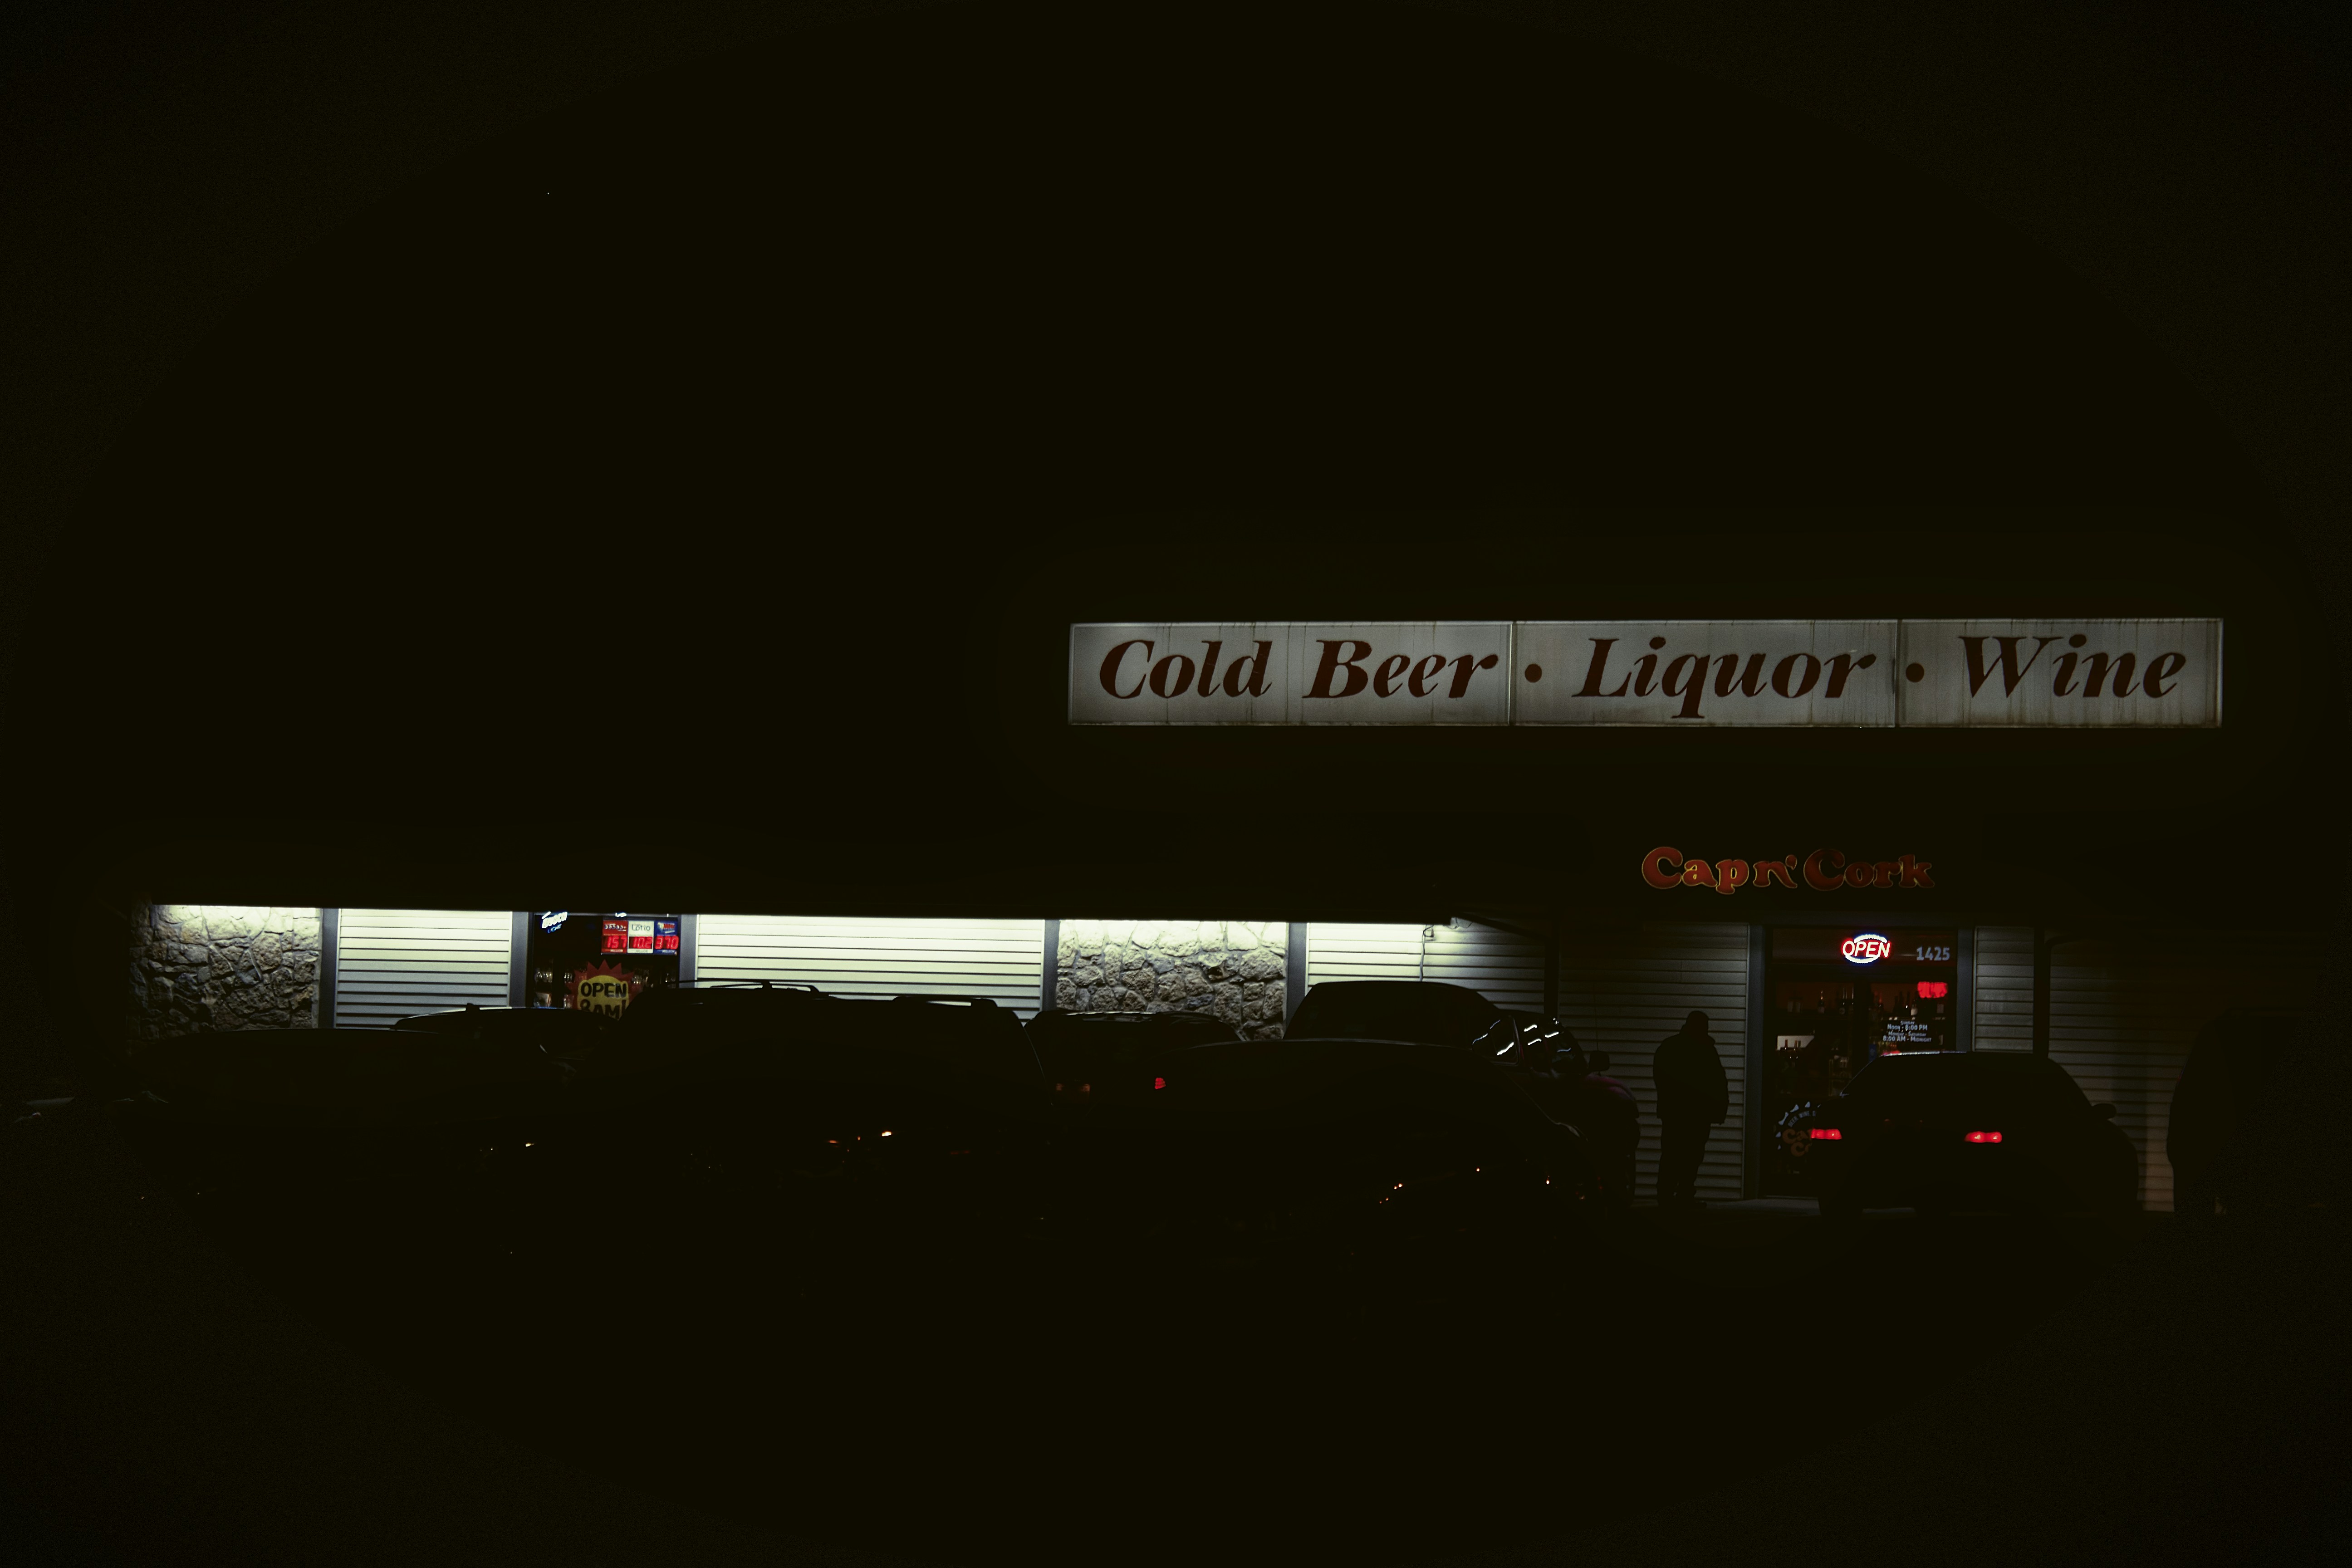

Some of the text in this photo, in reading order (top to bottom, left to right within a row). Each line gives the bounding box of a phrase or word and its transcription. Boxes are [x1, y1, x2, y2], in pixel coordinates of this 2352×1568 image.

[1099, 634, 2186, 718] Cold Beer Liquor Wine
[1803, 848, 1935, 891] Cork
[548, 924, 562, 933] LIGHT
[607, 936, 627, 948] 157
[655, 936, 679, 950] 370
[1842, 940, 1891, 958] OPEN
[1916, 946, 1950, 961] 1425
[581, 982, 627, 997] OPEN
